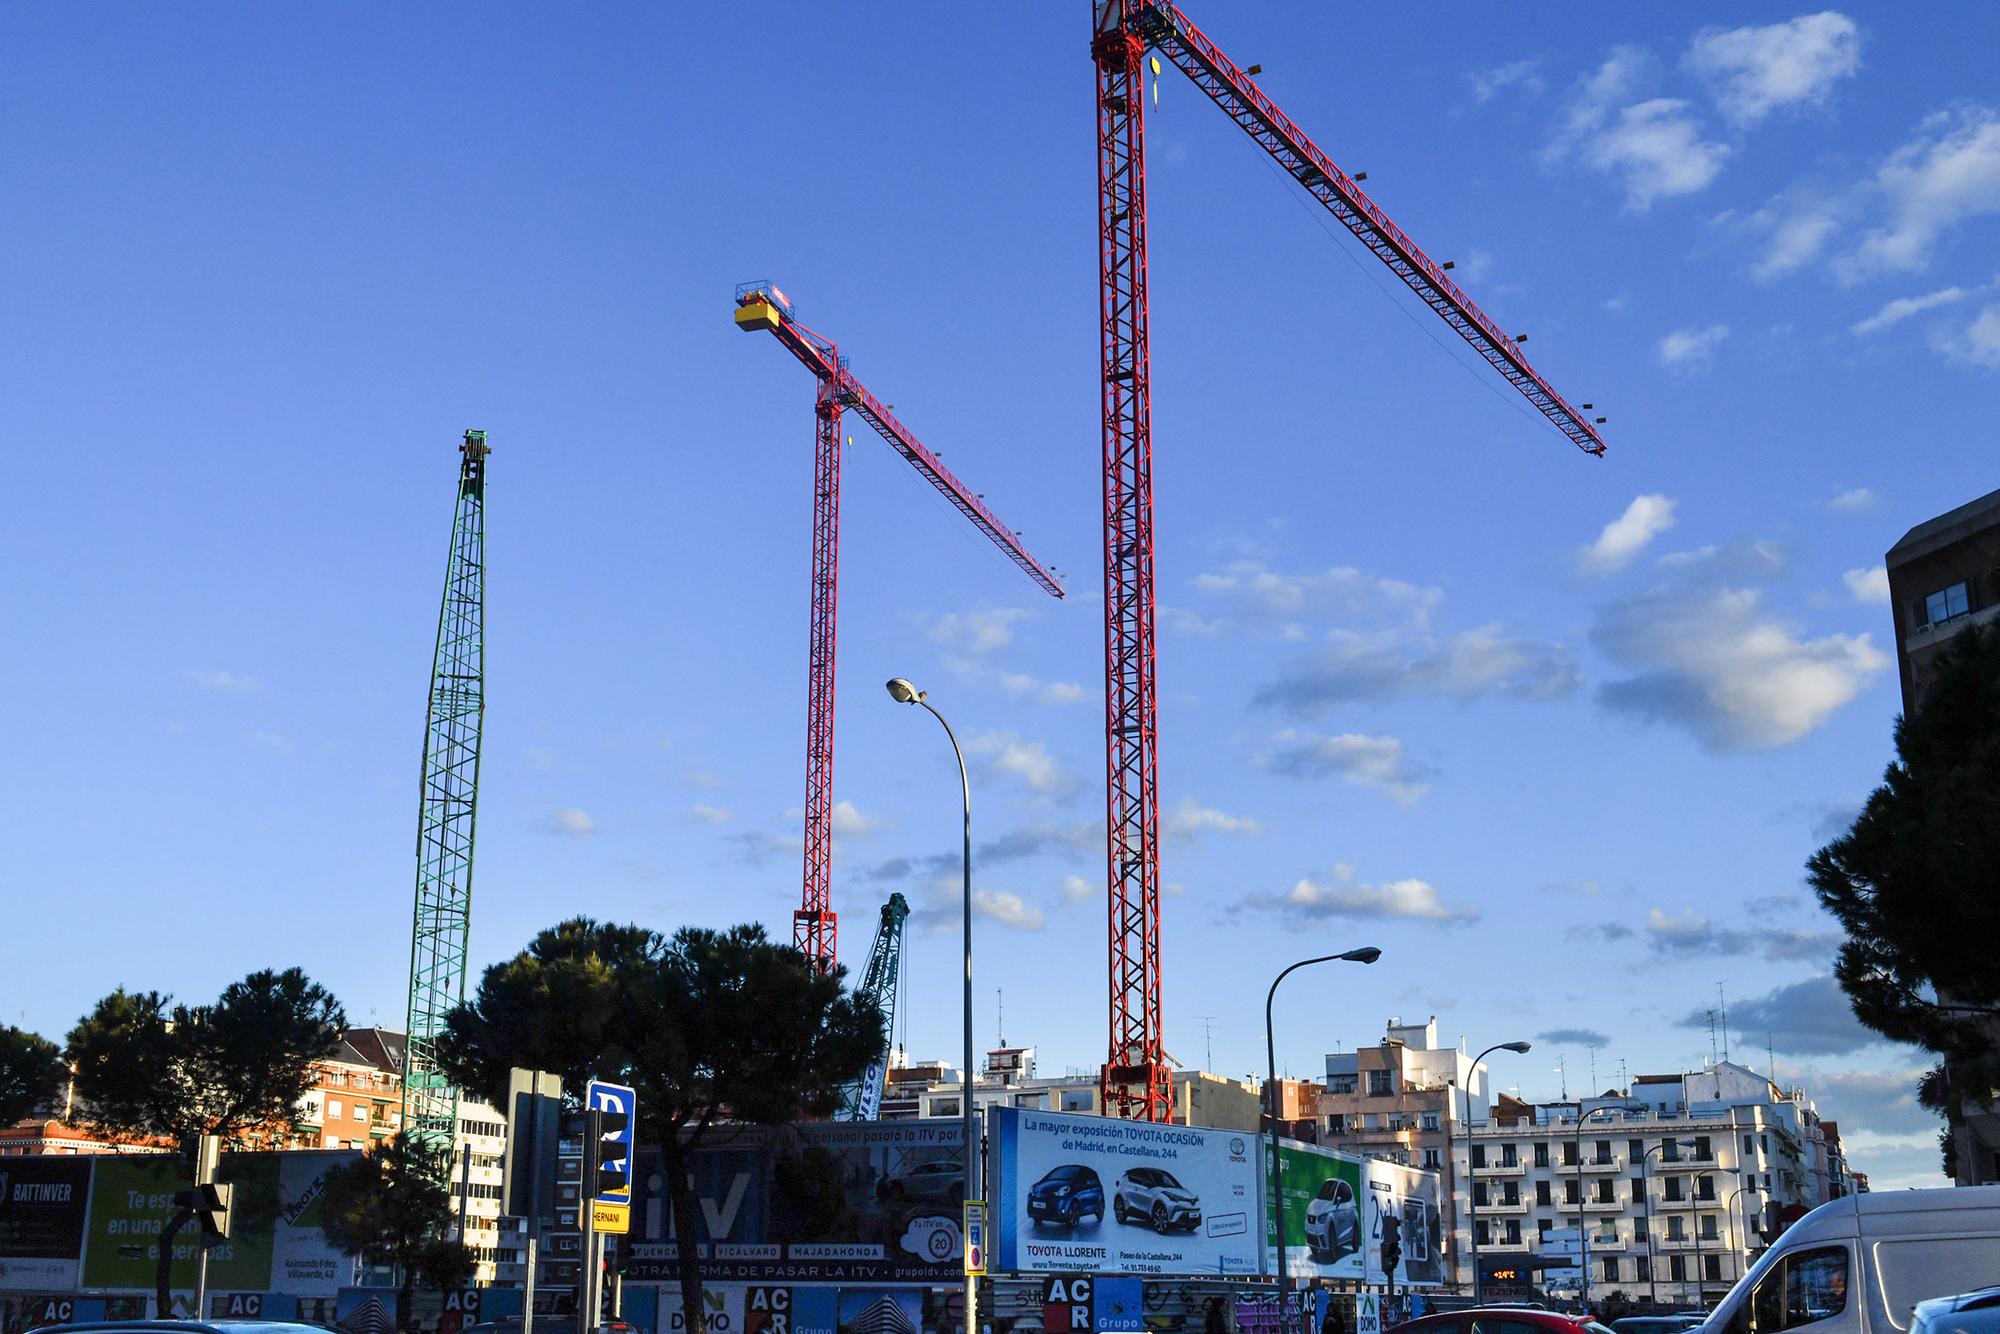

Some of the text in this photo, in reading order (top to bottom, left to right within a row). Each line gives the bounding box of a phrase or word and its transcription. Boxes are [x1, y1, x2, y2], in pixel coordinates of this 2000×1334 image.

[904, 1129, 916, 1141] la
[919, 1129, 936, 1141] ITV
[938, 1131, 958, 1143] por
[1024, 1118, 1205, 1146] La mayor exposición TOYOTA OCASIÓN
[1062, 1139, 1178, 1159] de Madrid, en Castellana, 244
[1229, 1155, 1247, 1163] TOYOTA
[12, 1183, 73, 1202] BATTINVER
[127, 1190, 145, 1209] Te
[284, 1185, 315, 1226] LEROY
[107, 1219, 128, 1234] en
[132, 1219, 161, 1234] una
[636, 1246, 705, 1257] FUENCAL
[794, 1246, 878, 1257] MAJADAHONDA
[934, 1238, 948, 1250] 20
[1027, 1245, 1106, 1259] TOYOTA LLORENTE
[1224, 1257, 1243, 1265] TOYOTA
[629, 1266, 673, 1277] OTRA
[677, 1266, 733, 1278] RMA
[738, 1266, 759, 1277] DE
[764, 1266, 820, 1277] PASAR
[825, 1266, 844, 1277] LA
[851, 1266, 877, 1277] ITV
[751, 1288, 789, 1311] AC
[1048, 1279, 1090, 1303] AC
[1482, 1287, 1528, 1297] TEZENIS
[229, 1294, 260, 1315] AC
[446, 1291, 479, 1311] AC
[1303, 1291, 1316, 1313] AC
[1402, 1295, 1412, 1313] AC
[44, 1301, 72, 1321] AC
[1070, 1305, 1091, 1329] R
[671, 1312, 730, 1331] DMO
[1098, 1317, 1139, 1332] Grupo
[1360, 1316, 1378, 1332] DOMO
